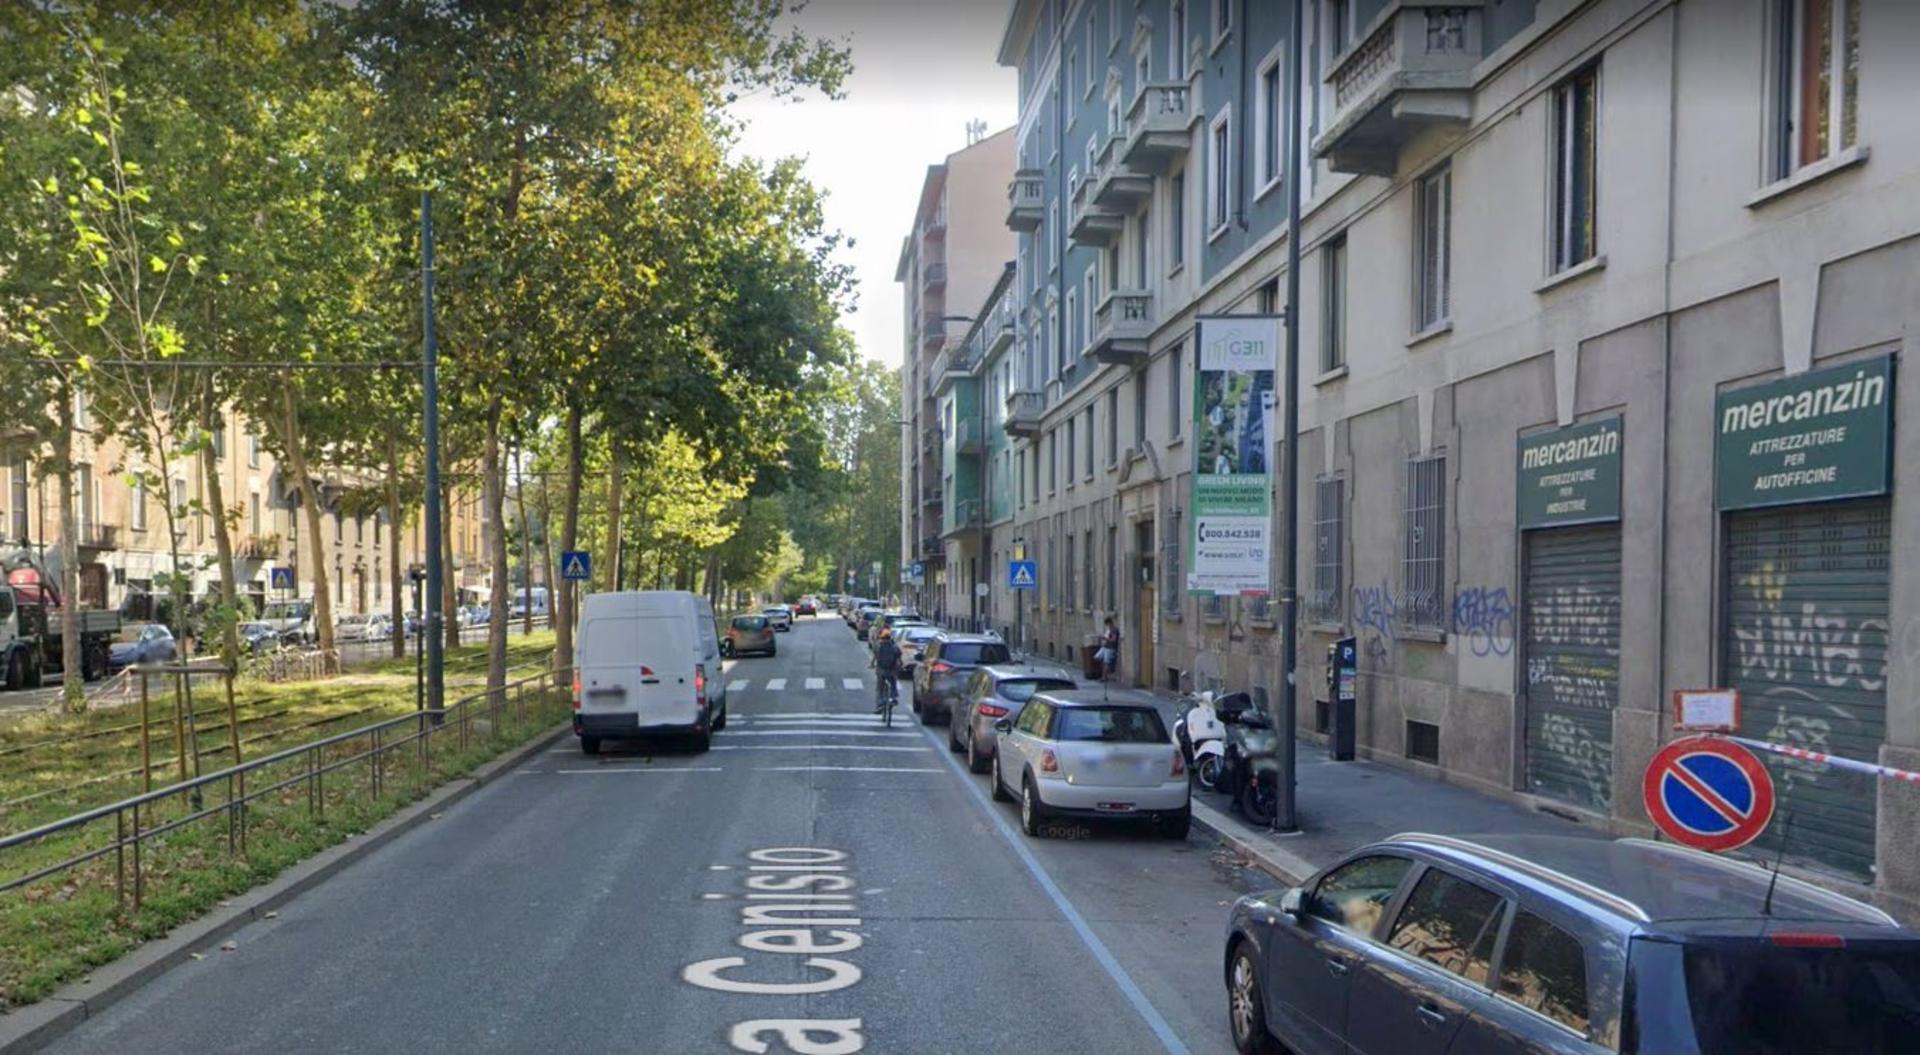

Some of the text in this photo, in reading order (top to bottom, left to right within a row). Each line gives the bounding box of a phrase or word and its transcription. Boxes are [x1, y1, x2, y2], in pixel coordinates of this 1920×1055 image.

[1722, 370, 1885, 434] mercanzin
[1522, 426, 1618, 470] mercanzin
[1749, 427, 1847, 456] ATTREZZATURE
[1784, 452, 1806, 467] PER
[1754, 466, 1837, 490] AUTOFFICINE
[683, 847, 864, 994] Cenisio
